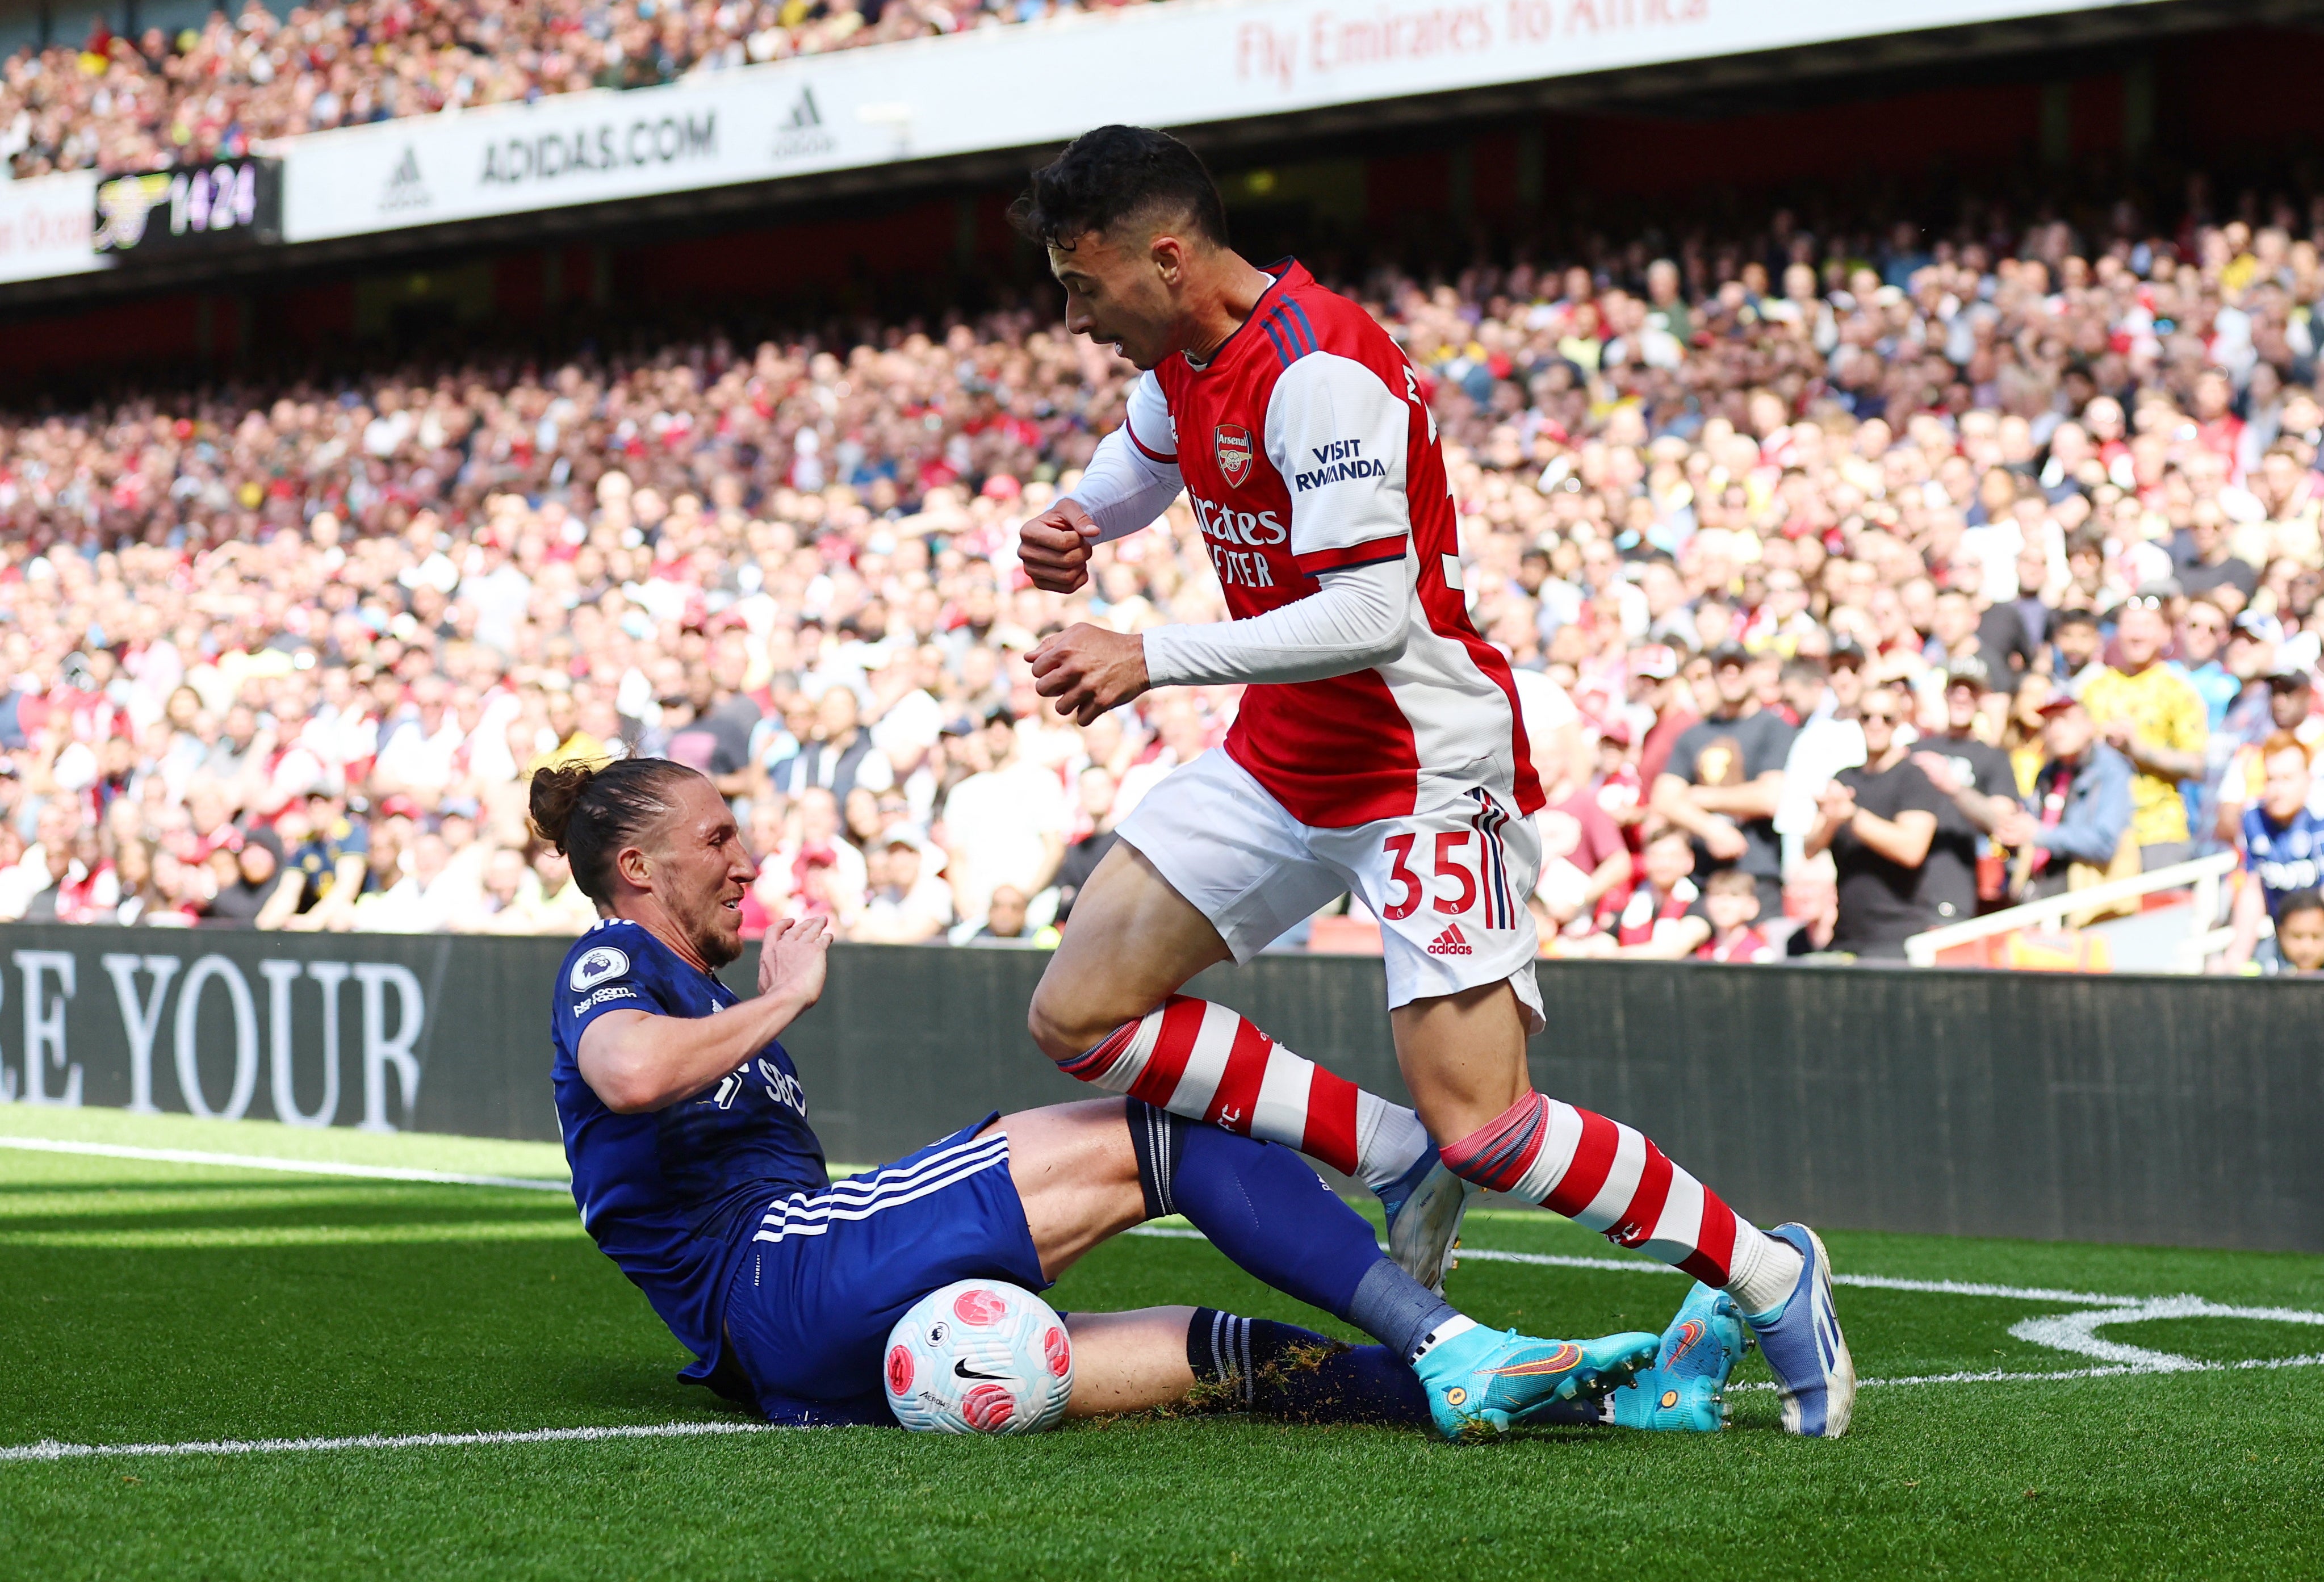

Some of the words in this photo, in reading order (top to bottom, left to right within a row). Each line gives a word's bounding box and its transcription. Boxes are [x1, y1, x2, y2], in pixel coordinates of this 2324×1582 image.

[479, 109, 720, 185] ADIDAS.COM
[1218, 433, 1247, 447] Arsenal
[1312, 439, 1360, 464] VISIT
[1295, 458, 1385, 492] RWANDA
[1191, 484, 1287, 546] irates
[1206, 542, 1274, 588] ETTER
[1383, 831, 1476, 920] 35
[1427, 943, 1472, 955] adidas
[0, 949, 83, 1107] E
[101, 953, 424, 1133] YOUR
